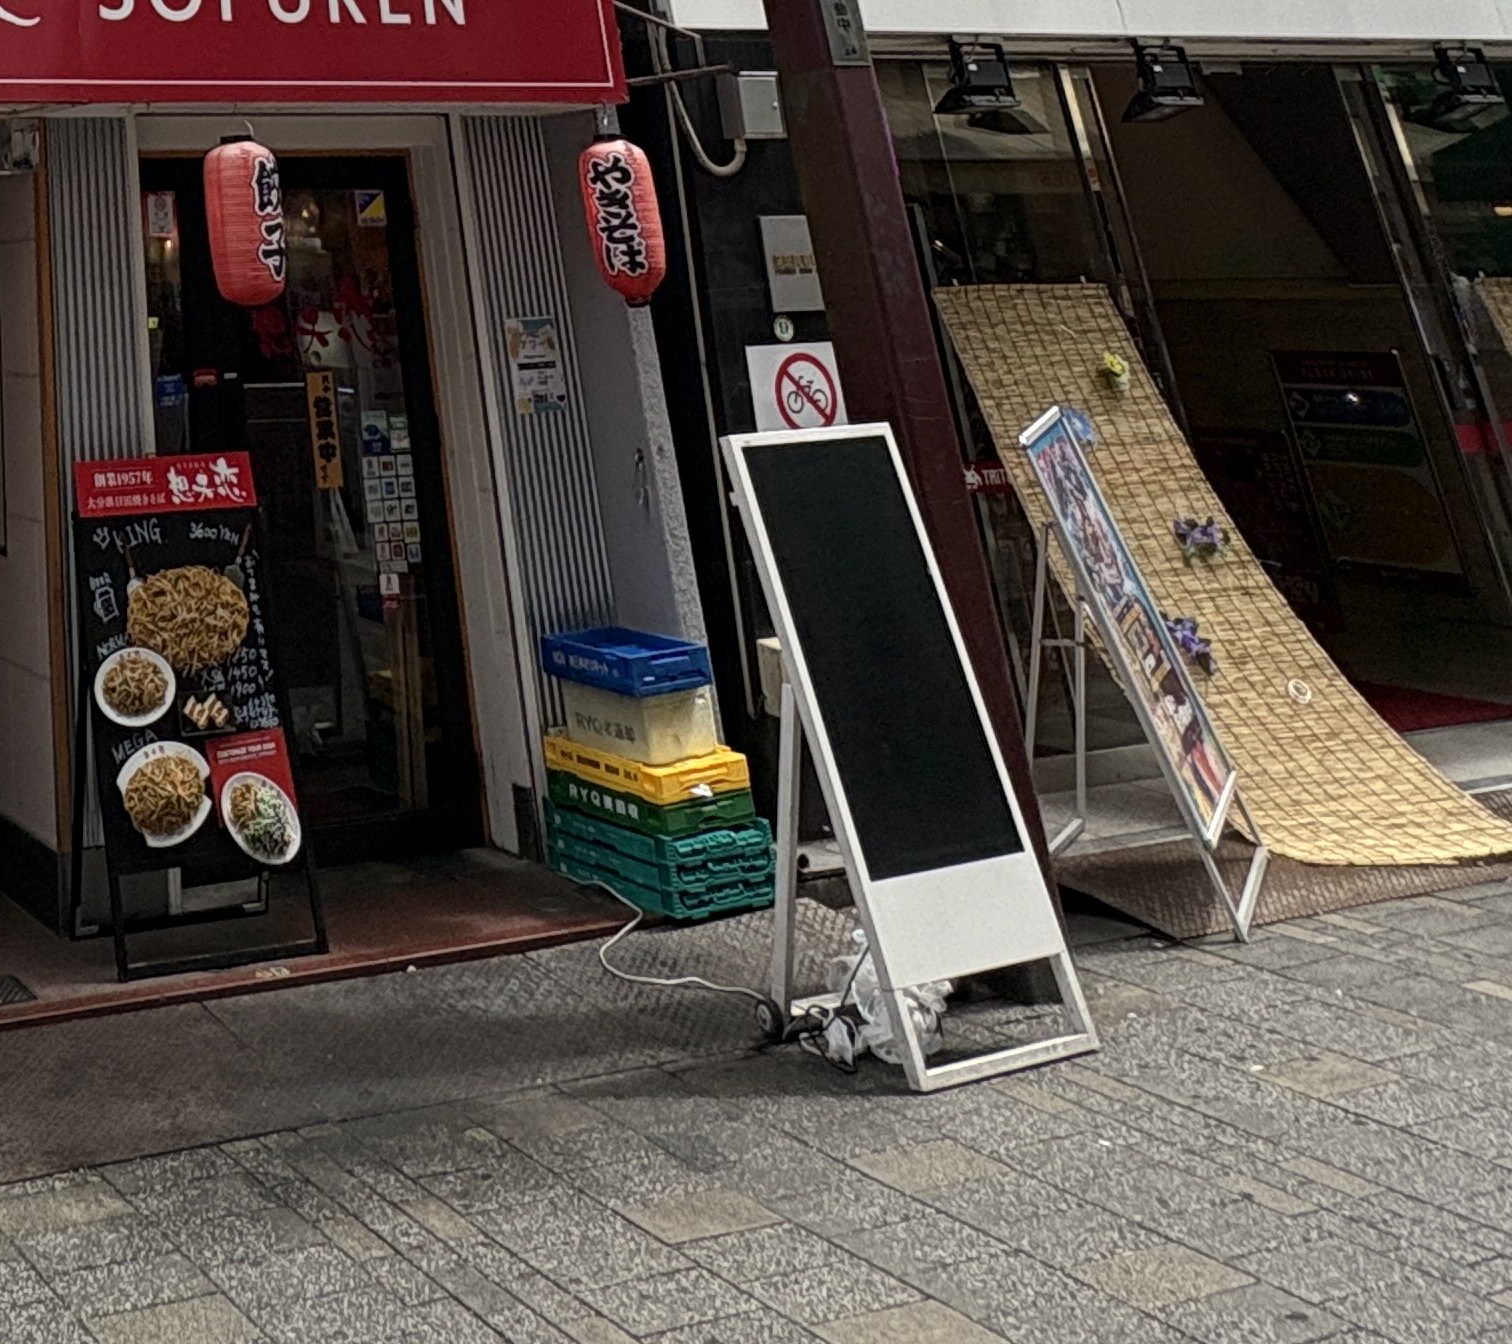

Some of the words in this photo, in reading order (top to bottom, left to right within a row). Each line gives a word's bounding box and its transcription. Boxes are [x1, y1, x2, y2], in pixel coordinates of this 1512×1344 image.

[589, 154, 648, 277] やきそば
[111, 729, 157, 764] MEGA
